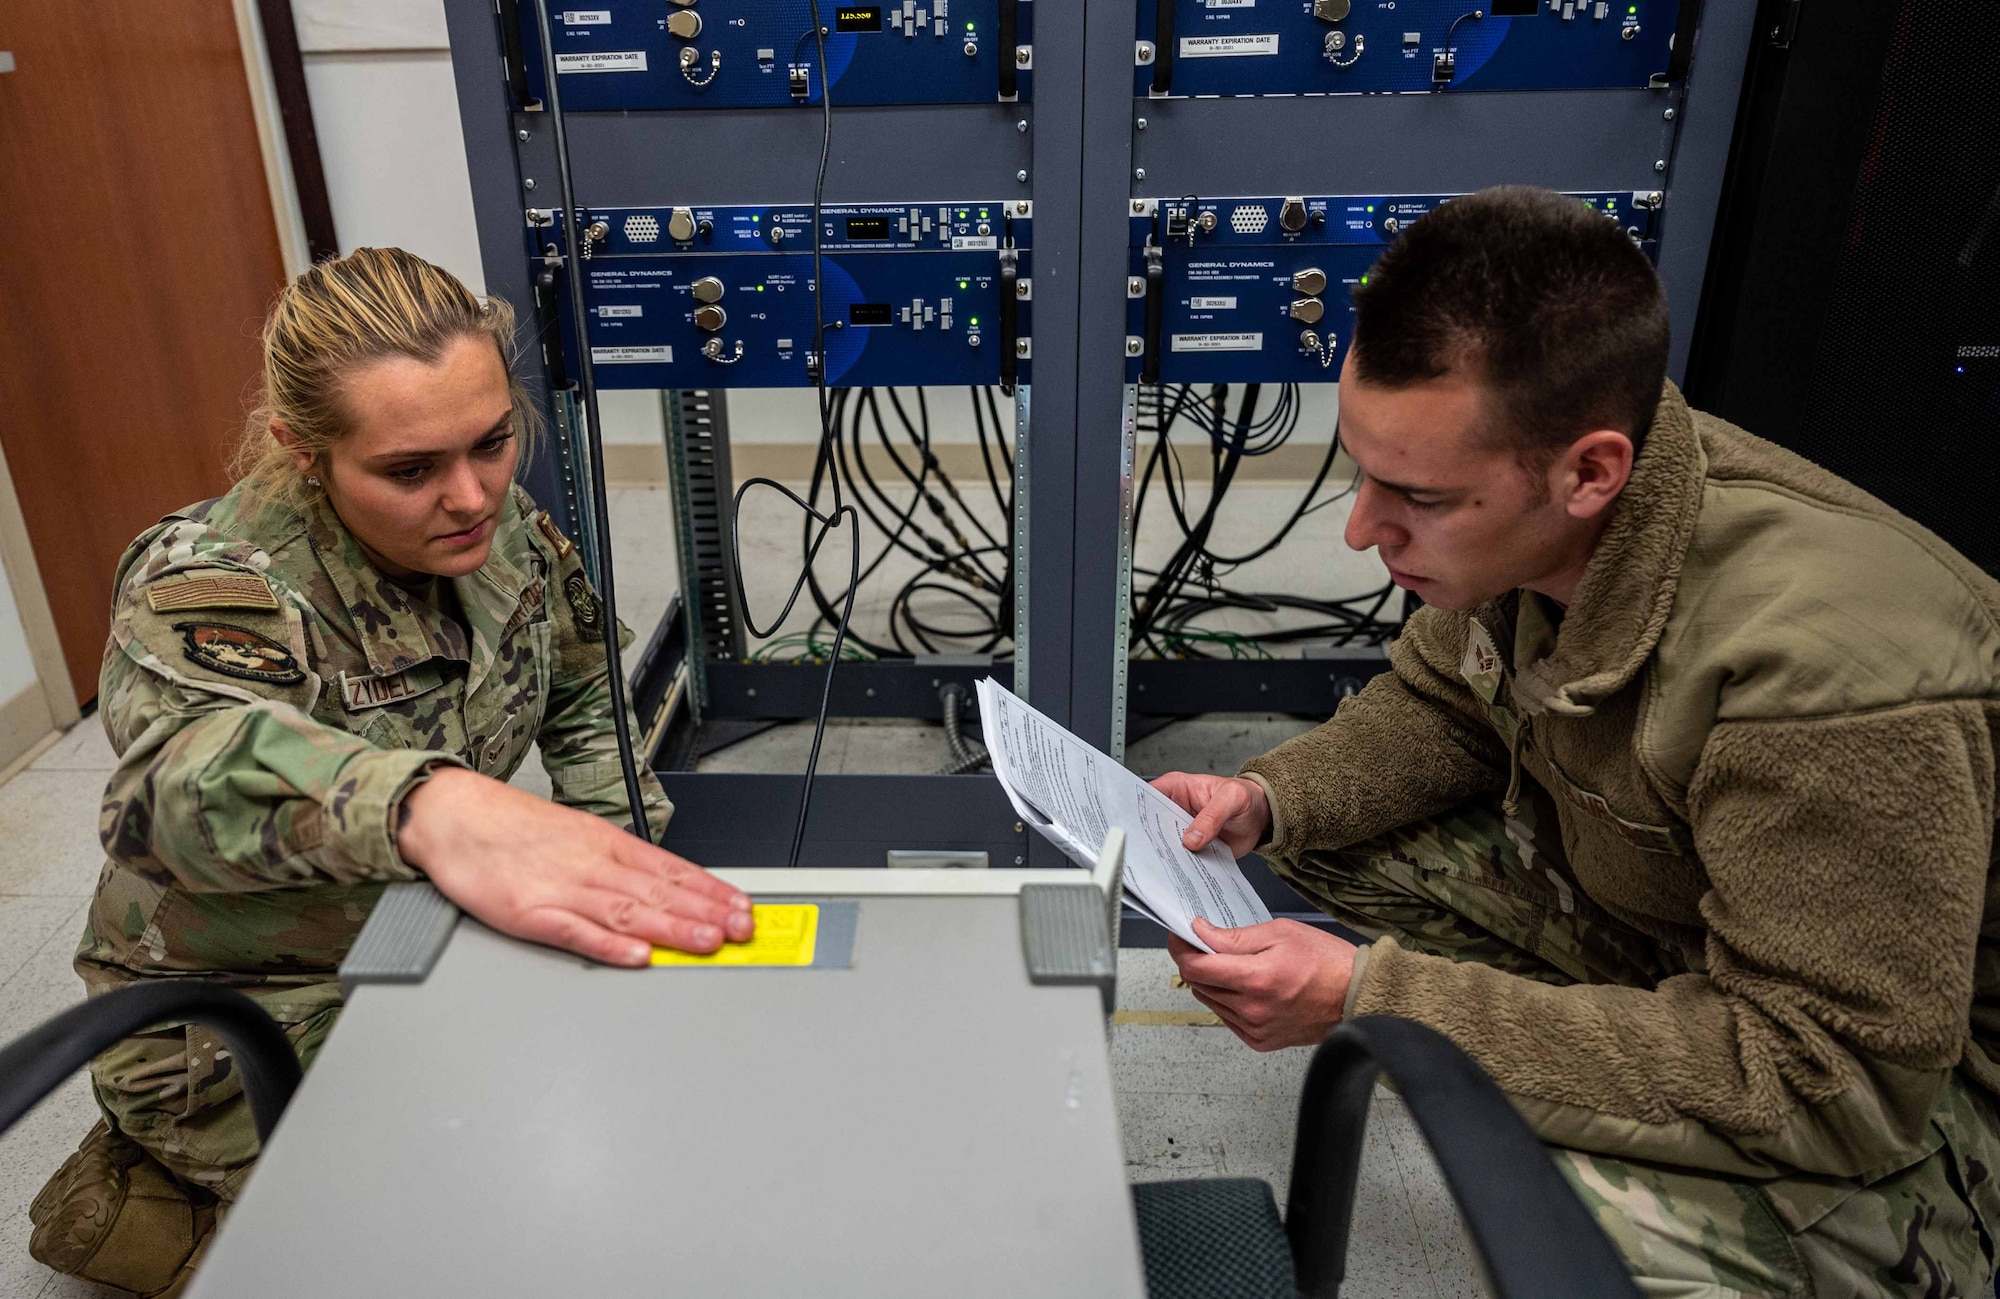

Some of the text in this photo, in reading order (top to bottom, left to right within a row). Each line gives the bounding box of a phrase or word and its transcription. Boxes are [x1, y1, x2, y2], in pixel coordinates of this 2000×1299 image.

[1187, 38, 1219, 46] WARRANTY
[1221, 37, 1254, 45] EXPIRATION
[348, 671, 416, 706] ZYDEL
